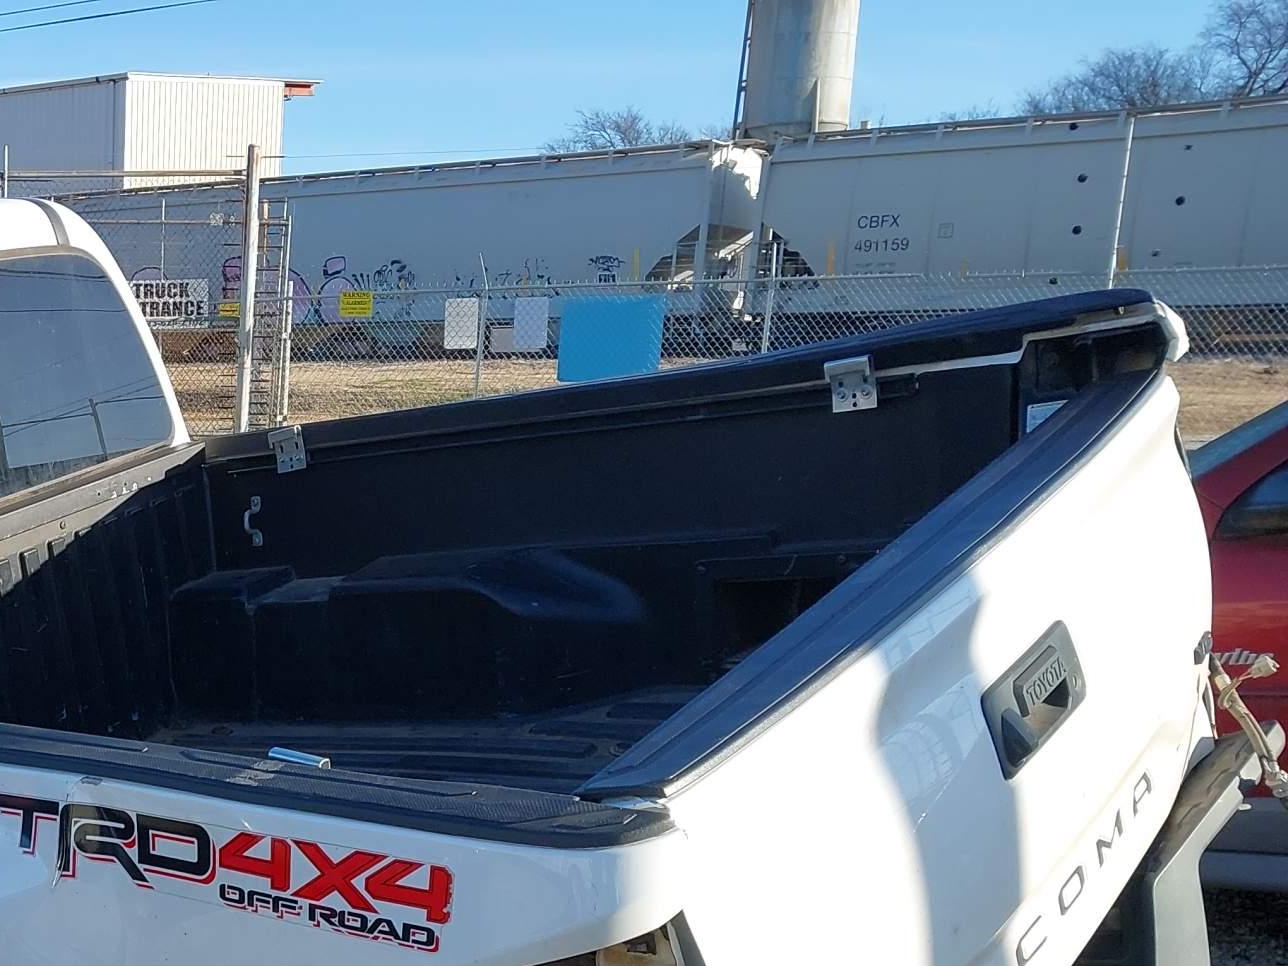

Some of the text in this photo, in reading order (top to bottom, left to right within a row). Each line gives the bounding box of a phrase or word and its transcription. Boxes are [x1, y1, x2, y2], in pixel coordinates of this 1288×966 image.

[857, 214, 901, 229] CBFX
[854, 237, 910, 252] 491159
[132, 282, 190, 299] TRUCK
[1026, 656, 1067, 705] TOYOTA
[218, 882, 440, 952] OFF ROAD
